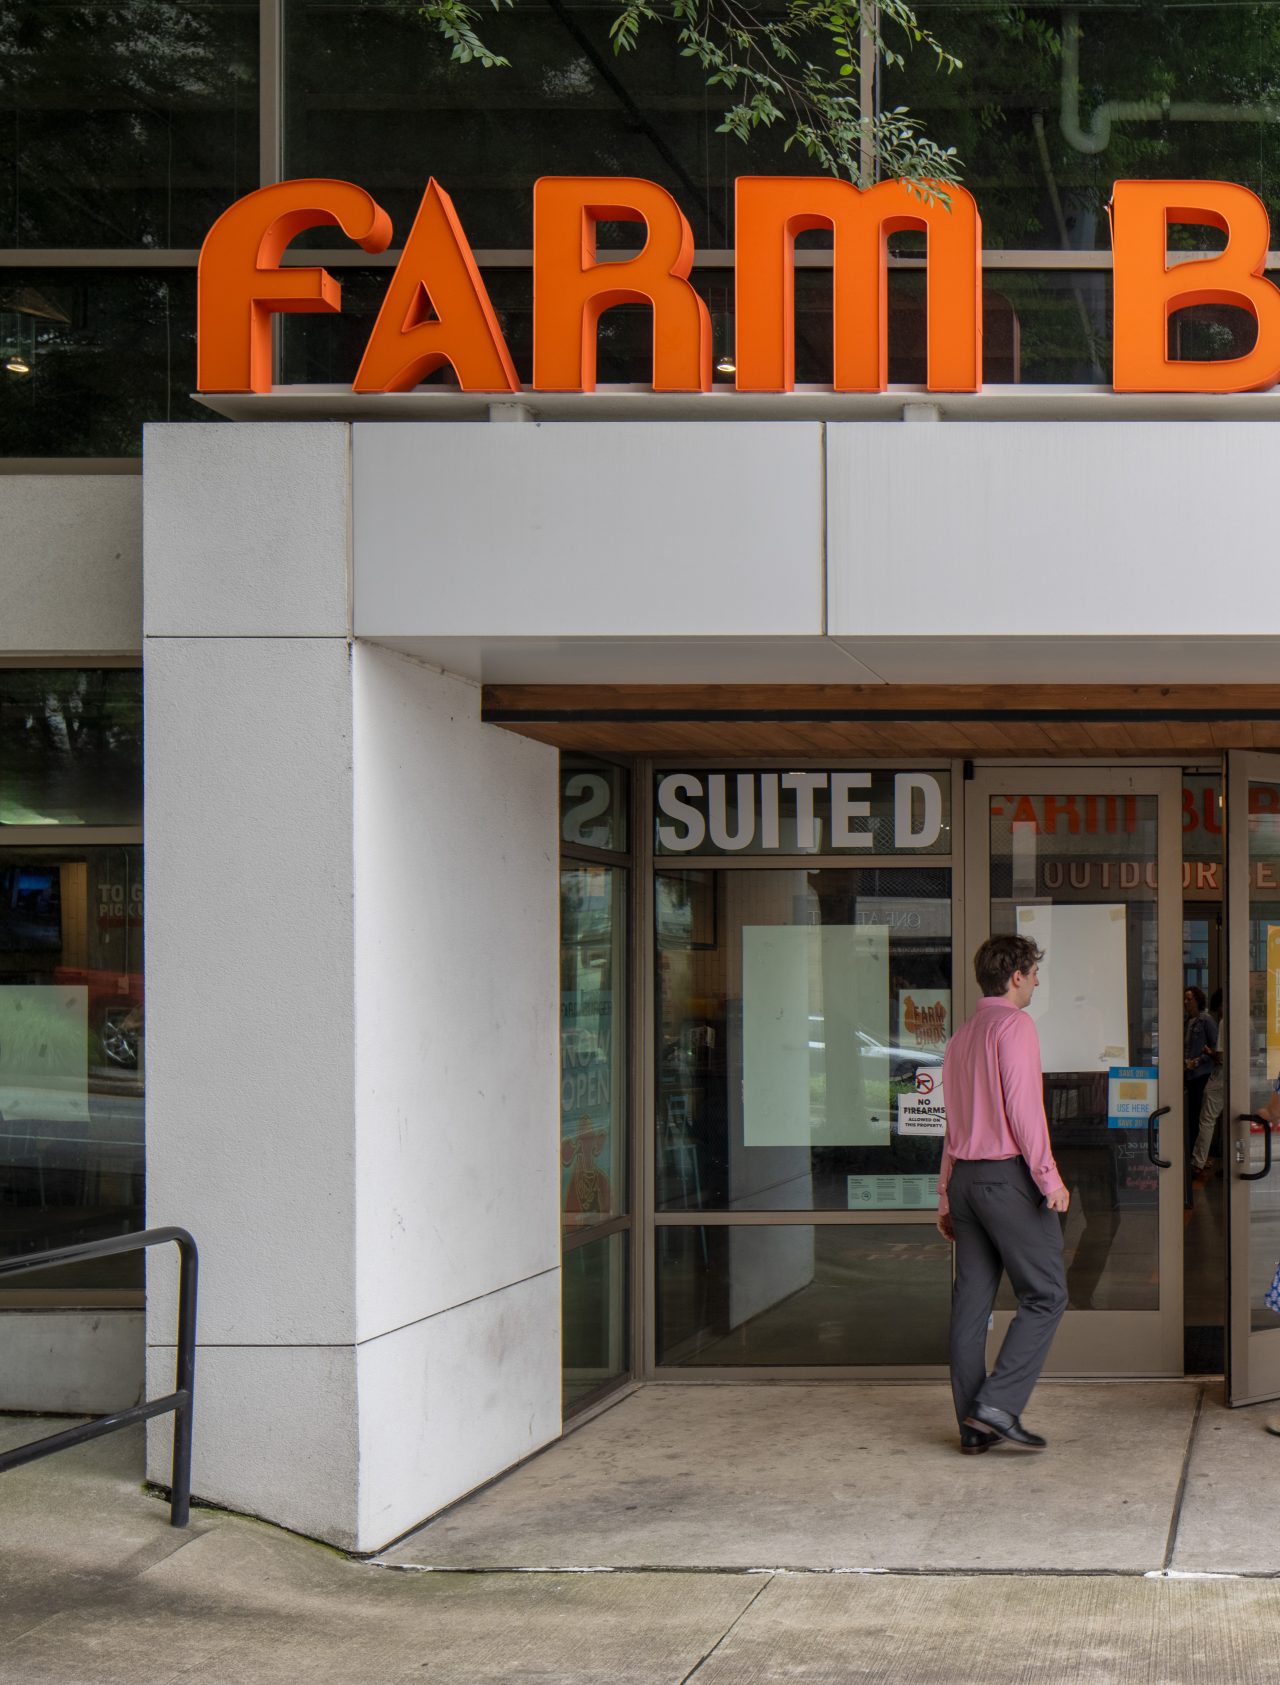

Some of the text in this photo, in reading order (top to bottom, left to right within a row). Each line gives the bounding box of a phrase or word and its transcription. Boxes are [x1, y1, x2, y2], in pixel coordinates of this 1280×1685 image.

[198, 176, 983, 393] FARM
[658, 772, 873, 851] SUITE
[894, 773, 942, 848] D
[97, 884, 124, 902] TO
[913, 1005, 945, 1024] FARM
[915, 1026, 946, 1045] BIRDS
[561, 1070, 610, 1112] OPEN
[903, 1106, 946, 1115] FIREARMS
[918, 1098, 931, 1106] NO
[1117, 1103, 1150, 1112] USE HERE
